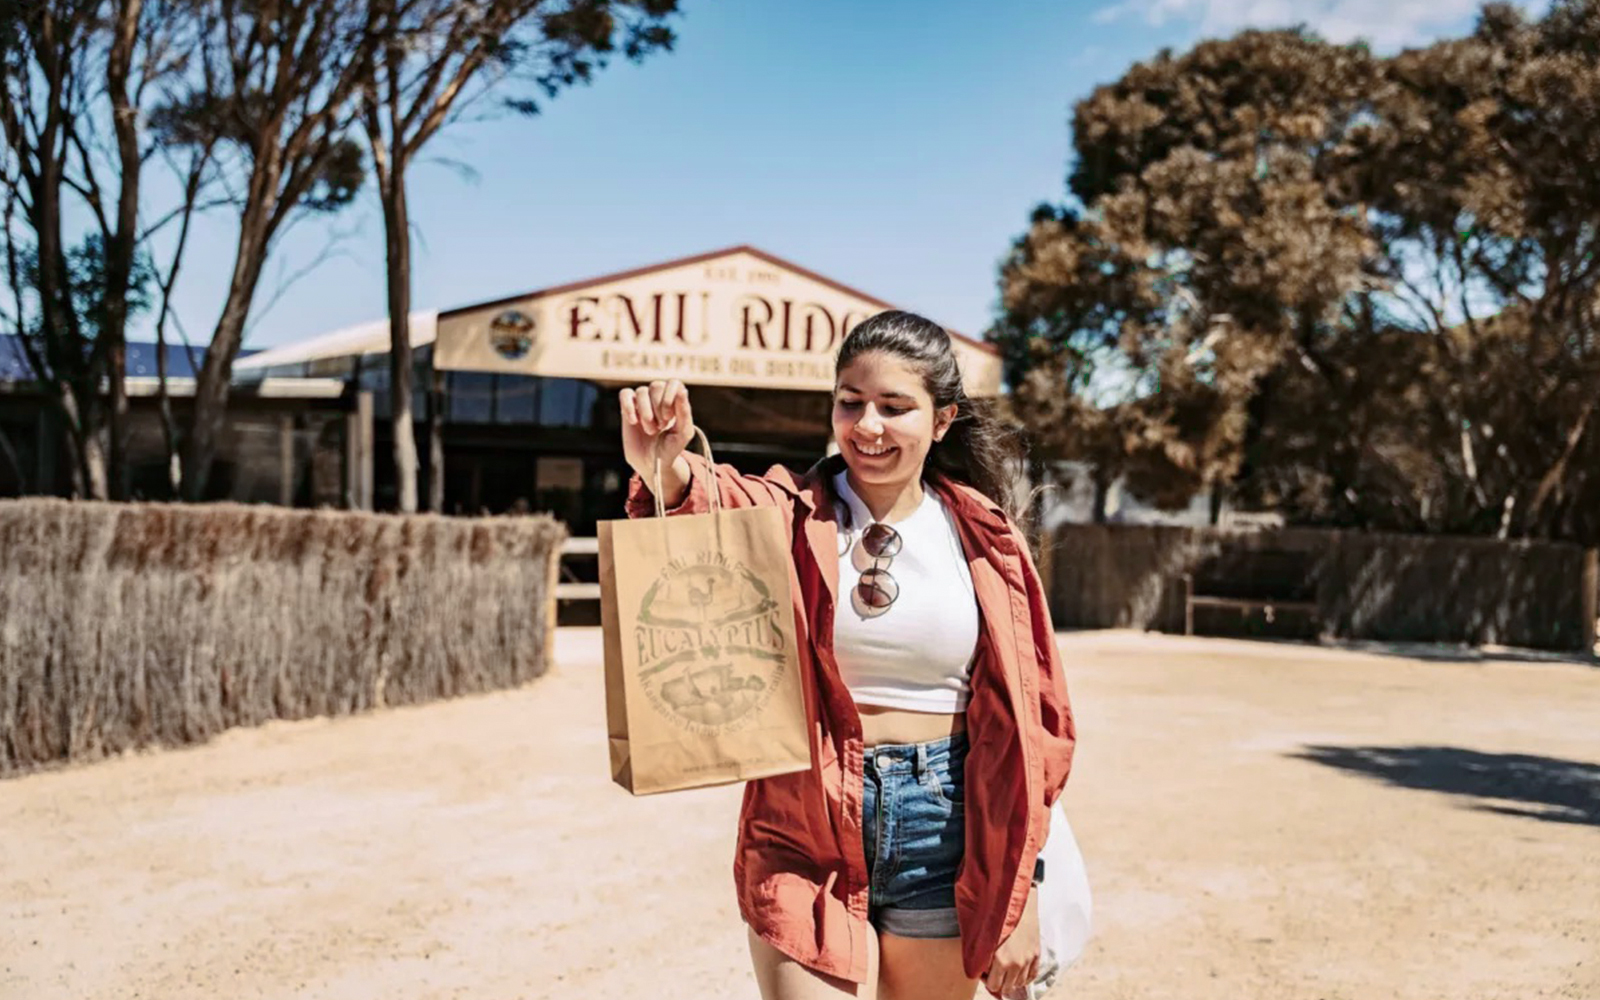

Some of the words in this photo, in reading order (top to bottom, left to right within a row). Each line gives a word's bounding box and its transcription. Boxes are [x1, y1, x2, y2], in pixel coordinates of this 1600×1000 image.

[562, 293, 709, 344] EMU
[601, 350, 720, 373] EUCALYPTUS
[729, 357, 757, 376] OIL
[765, 360, 831, 380] DISTILL
[660, 556, 687, 581] EMU
[634, 610, 785, 667] EUCALYPTUS
